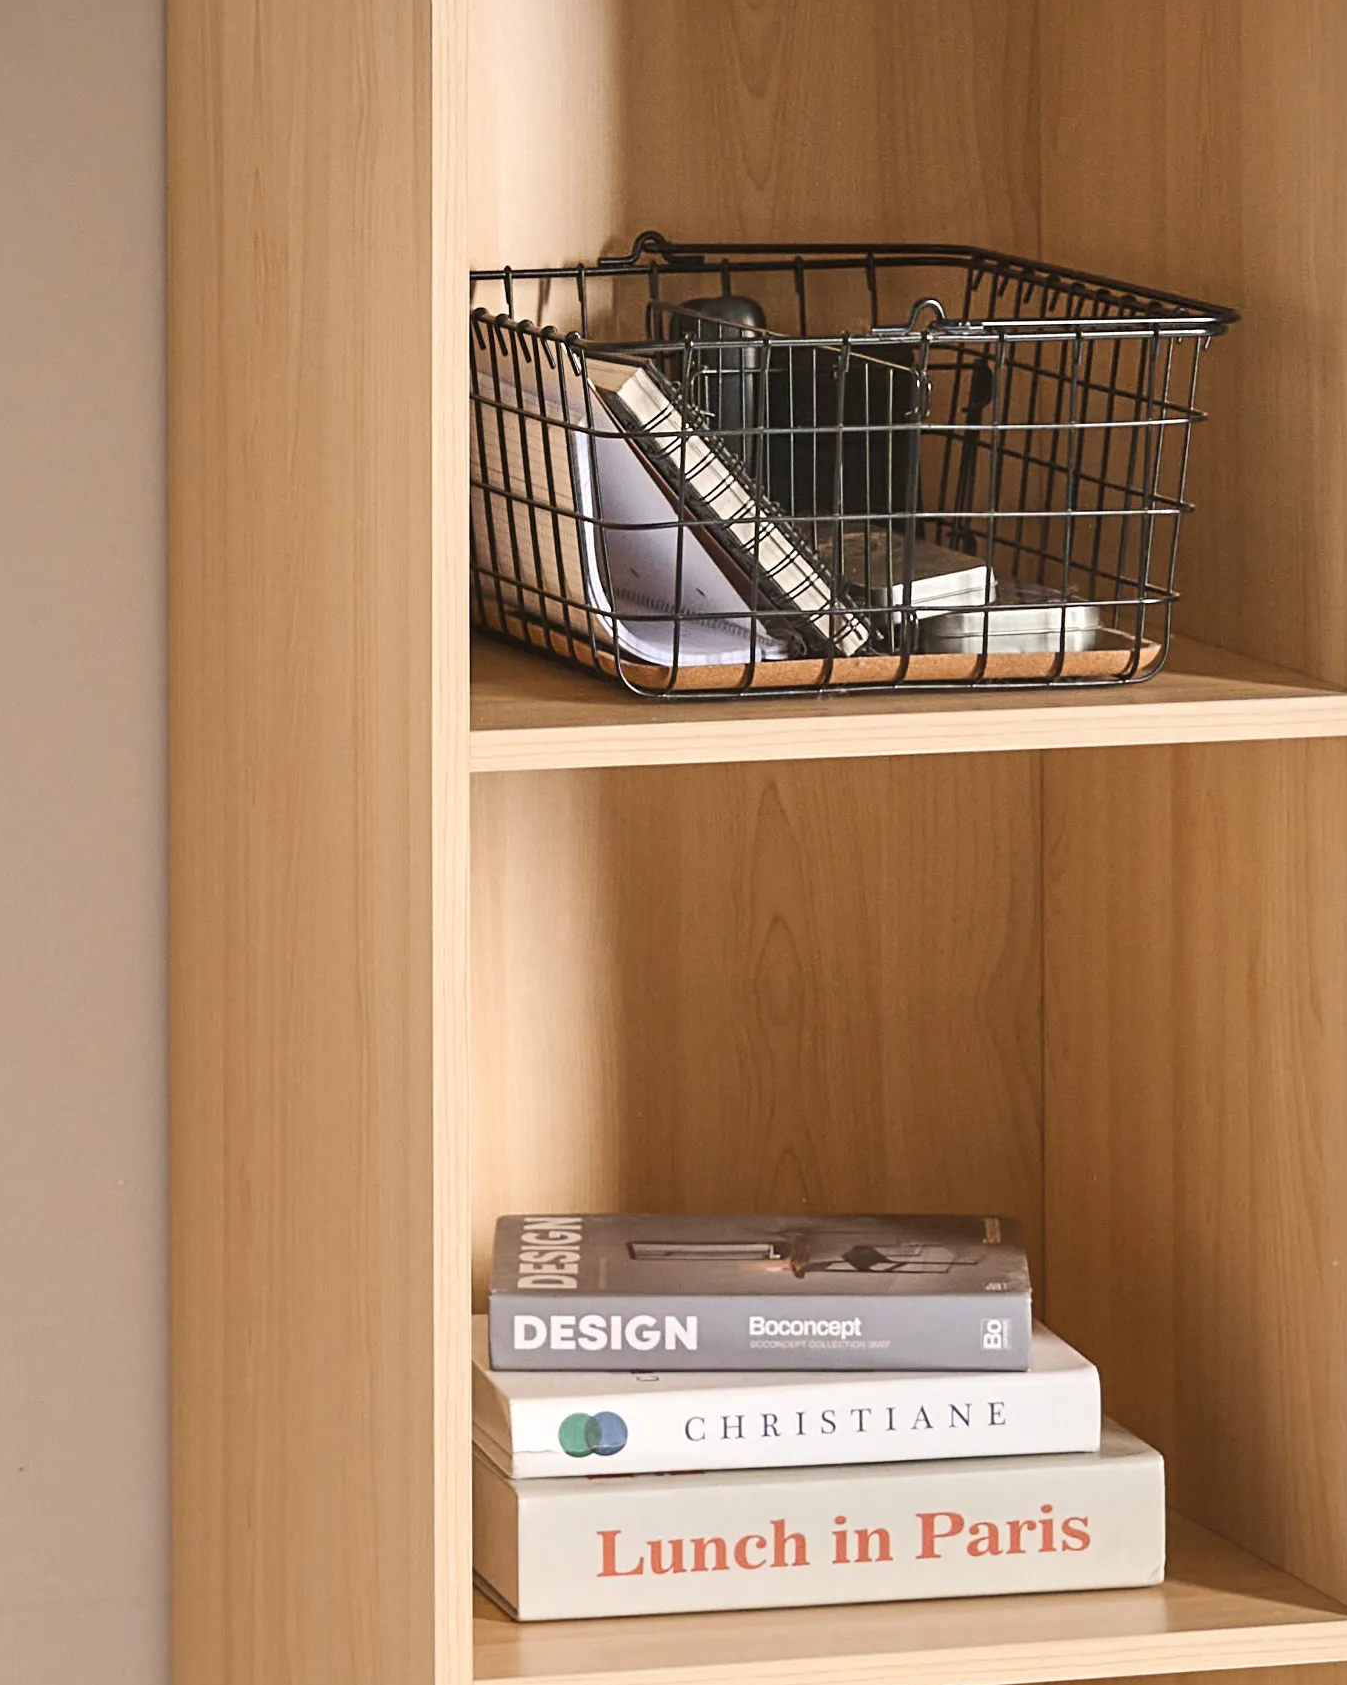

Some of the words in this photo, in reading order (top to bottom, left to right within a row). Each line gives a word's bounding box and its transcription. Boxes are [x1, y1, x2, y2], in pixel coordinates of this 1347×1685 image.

[517, 1216, 583, 1289] DESIGN
[513, 1315, 698, 1352] DESIGN
[750, 1317, 861, 1339] Boconcept
[983, 1320, 1002, 1348] Bo
[685, 1402, 1009, 1441] CHRISTIANE
[597, 1519, 808, 1577] Lunch
[832, 1516, 893, 1564] in
[916, 1505, 1090, 1559] Paris
